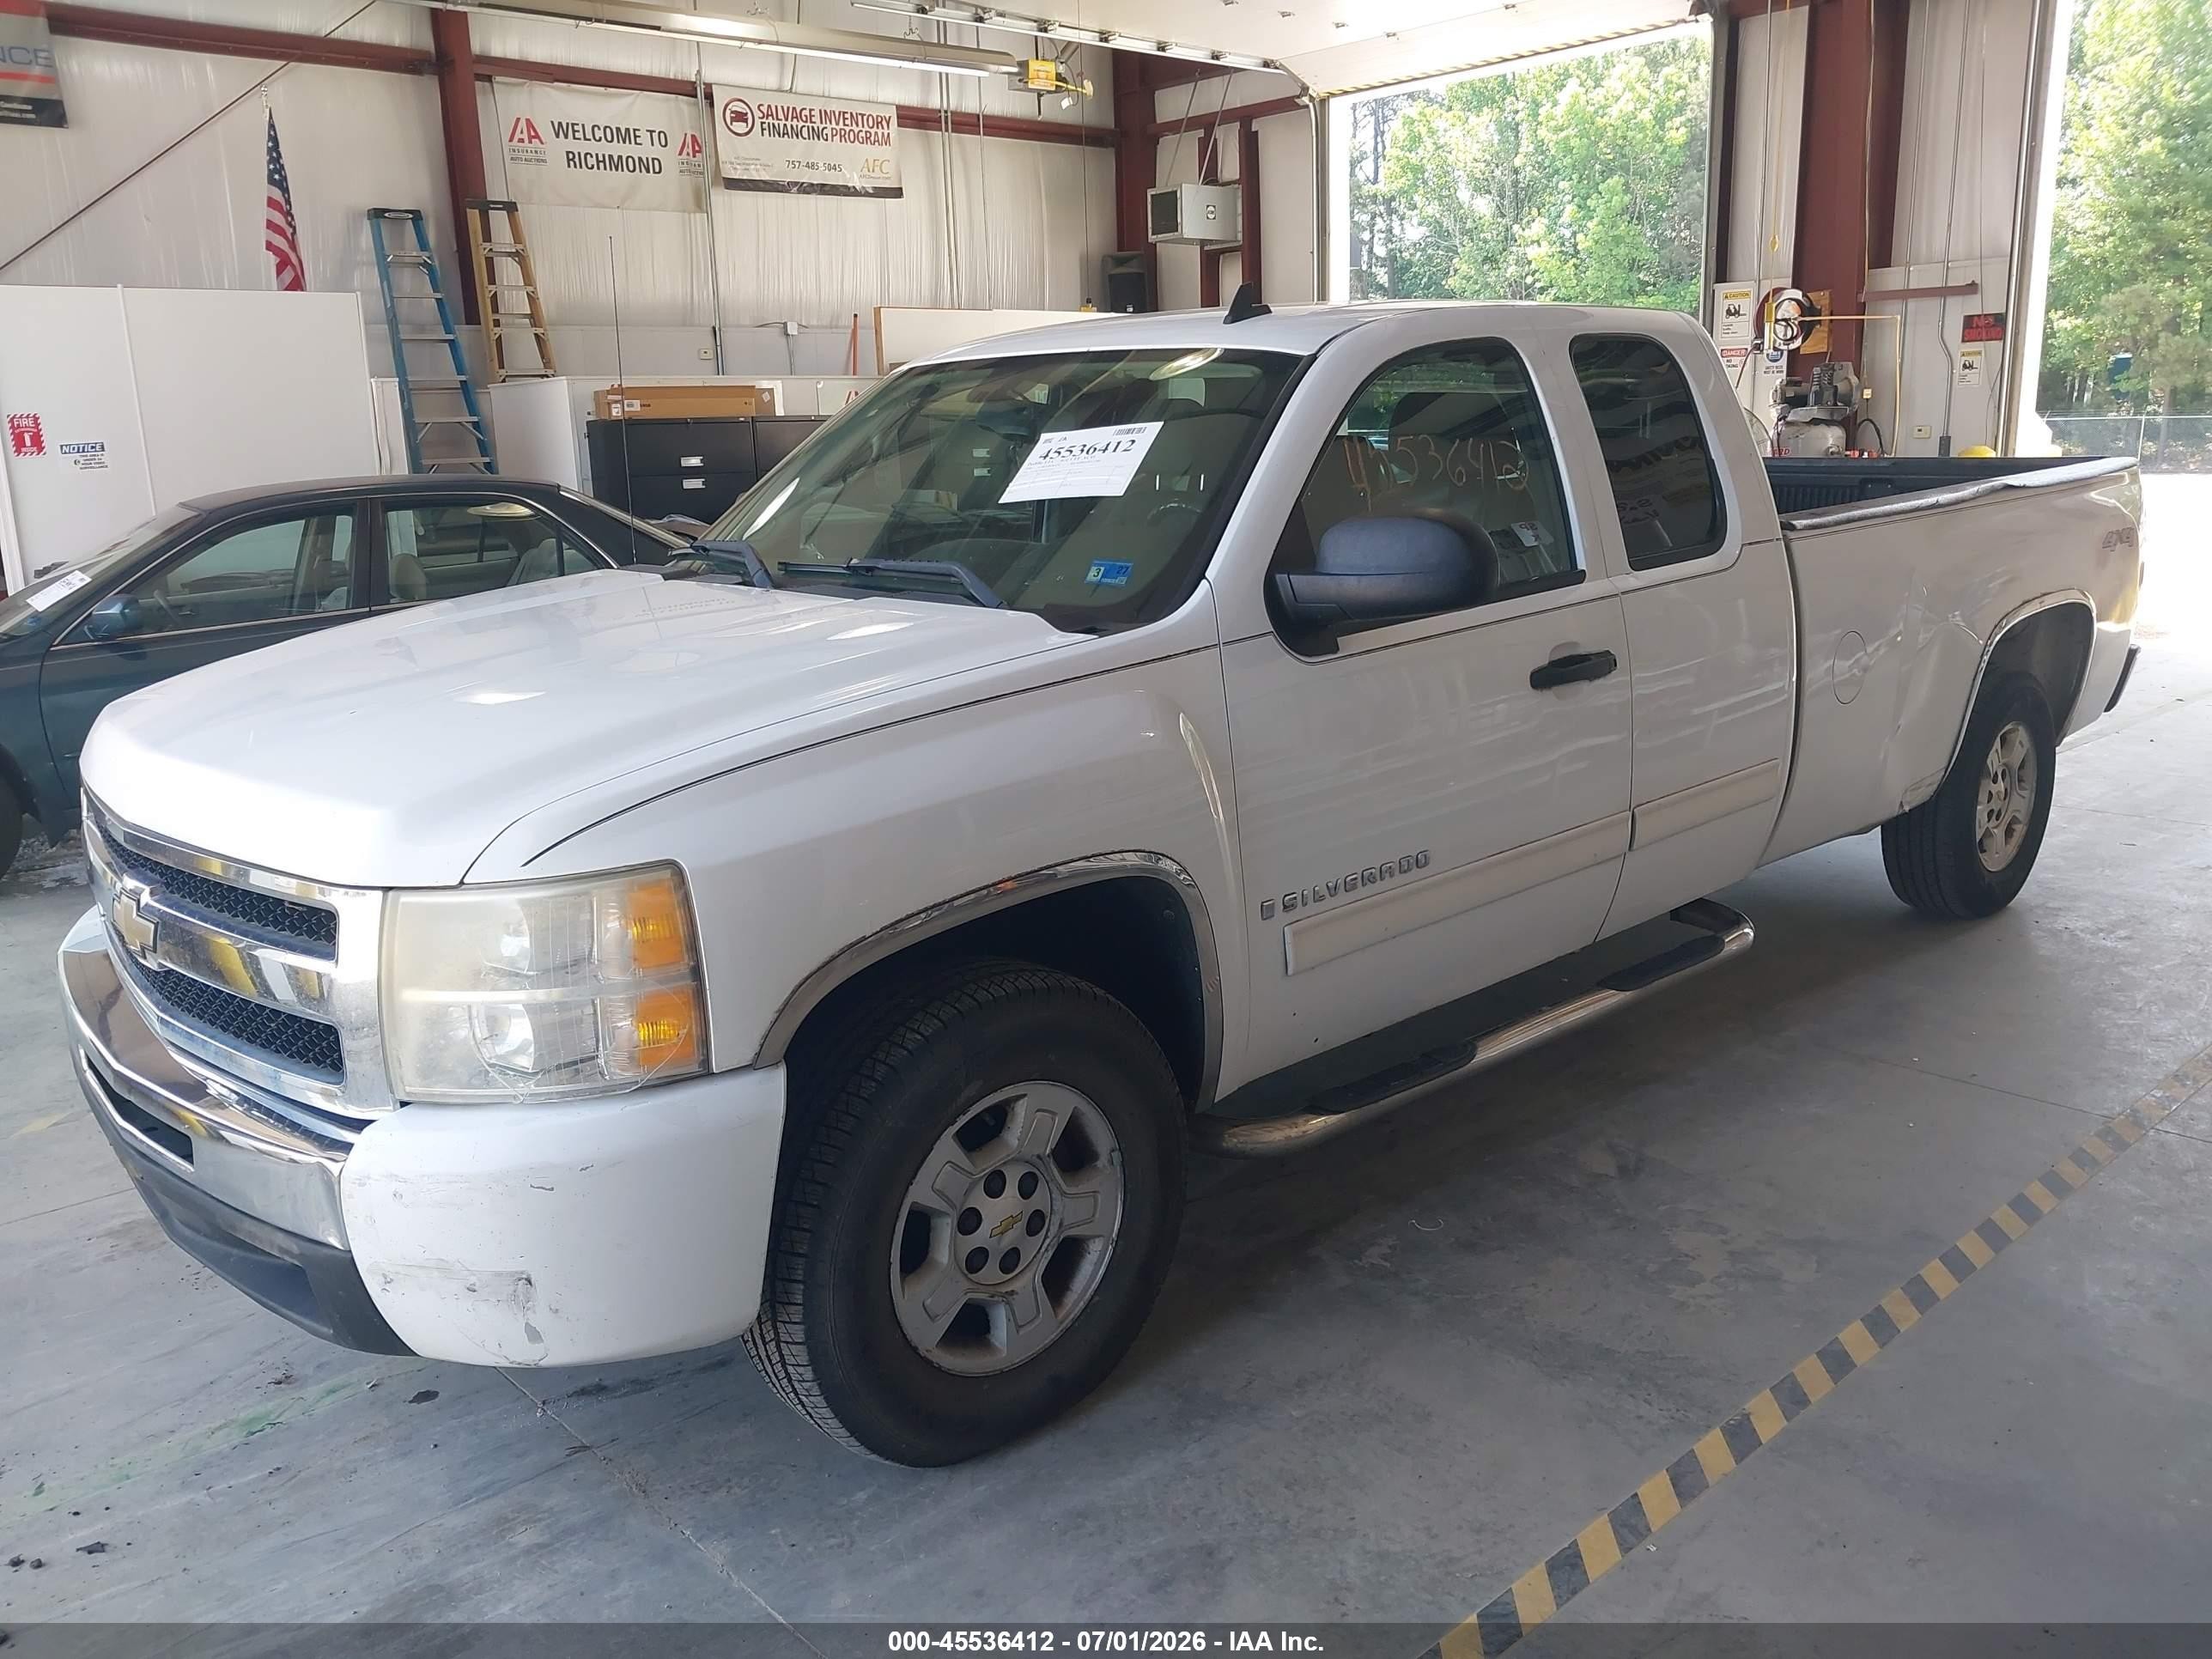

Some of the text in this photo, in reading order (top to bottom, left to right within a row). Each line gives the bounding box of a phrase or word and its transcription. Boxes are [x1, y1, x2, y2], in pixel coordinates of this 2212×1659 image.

[757, 103, 892, 130] SALVAGE INVENTORY
[550, 120, 669, 148] WELCOME TO
[760, 121, 891, 147] FINANCING PROGRAM
[565, 150, 662, 174] RICHMOND
[785, 160, 842, 173] 757-485-5045
[860, 158, 890, 175] AFC
[13, 417, 36, 428] FIRE
[62, 443, 104, 453] NOTICE
[1039, 439, 1136, 460] 45536412
[1093, 568, 1102, 578] 3
[1282, 849, 1430, 913] SILVERADO
